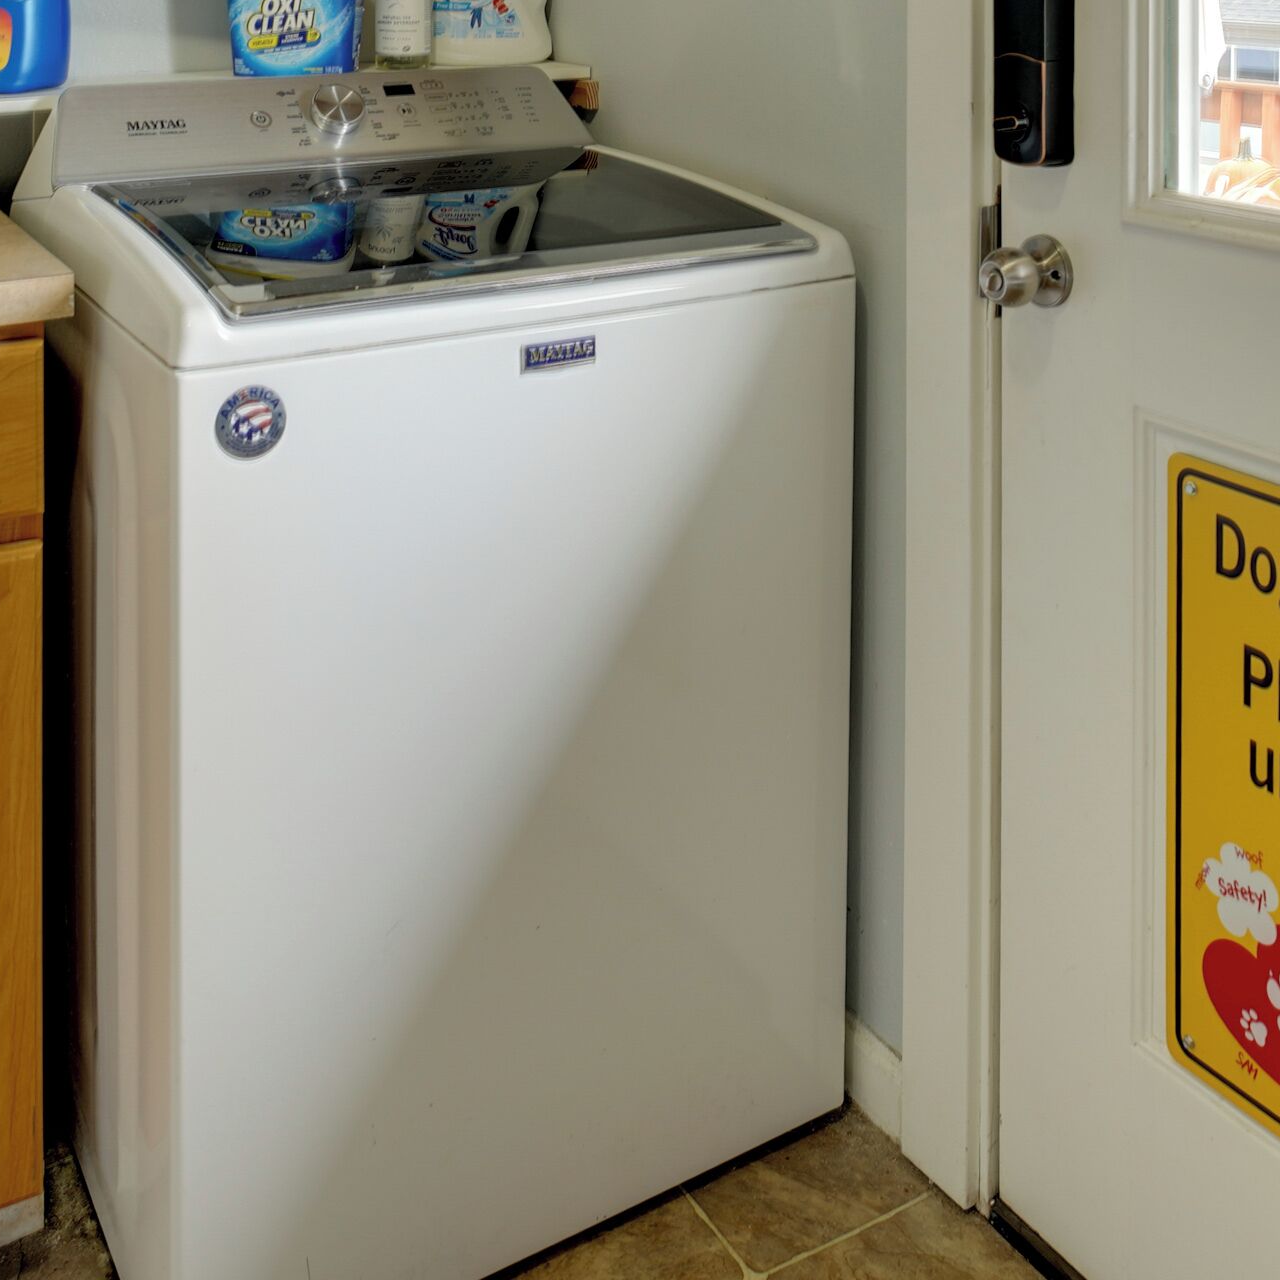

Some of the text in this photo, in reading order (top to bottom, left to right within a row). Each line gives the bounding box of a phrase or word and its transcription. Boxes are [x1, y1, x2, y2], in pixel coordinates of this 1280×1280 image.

[247, 8, 315, 35] CLEAN
[127, 119, 186, 132] MAYTAG
[528, 339, 594, 363] MAYTAG
[221, 387, 280, 419] AMERICA
[1218, 877, 1267, 913] Safety!
